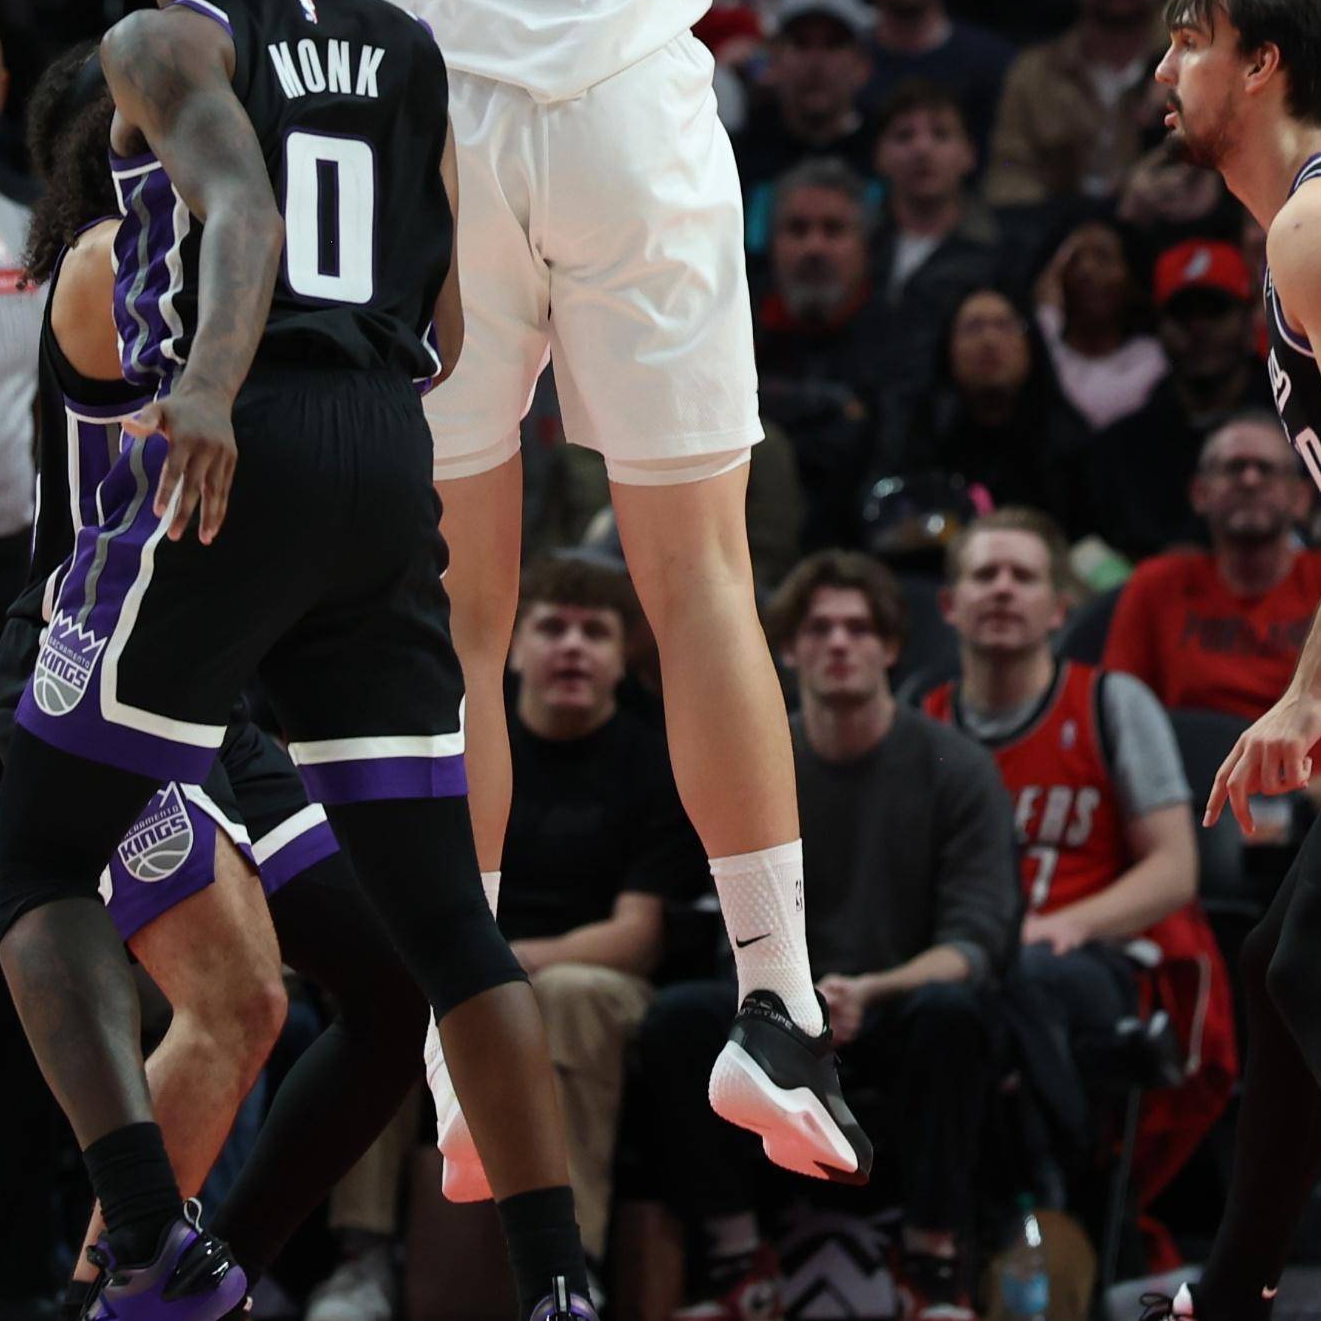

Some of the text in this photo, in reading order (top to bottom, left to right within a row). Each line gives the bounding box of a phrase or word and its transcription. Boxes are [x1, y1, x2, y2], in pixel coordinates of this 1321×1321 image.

[268, 38, 385, 100] MONK
[283, 129, 377, 306] 0
[39, 646, 87, 692] KINGS
[120, 814, 189, 862] KINGS
